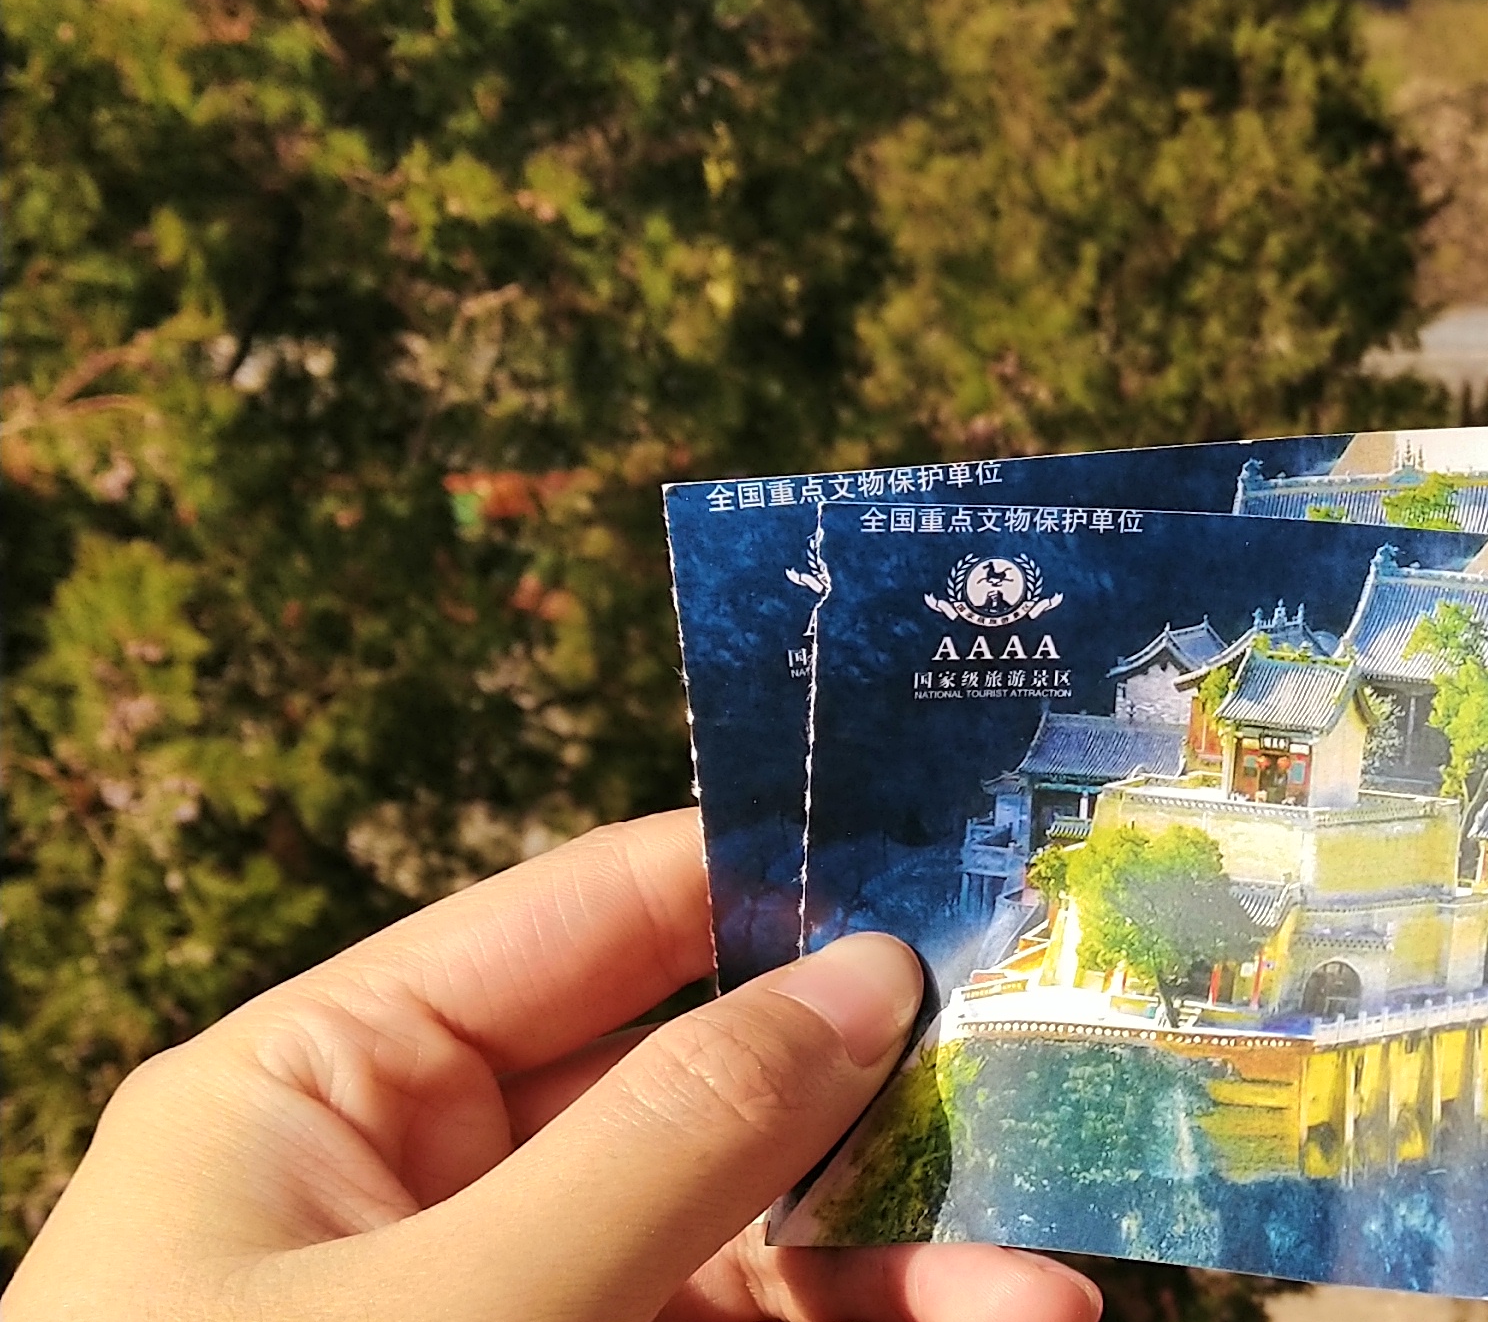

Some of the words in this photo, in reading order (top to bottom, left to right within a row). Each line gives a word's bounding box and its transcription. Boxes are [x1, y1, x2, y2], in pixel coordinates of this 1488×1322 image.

[705, 460, 1004, 513] 全国重点文物保护单位
[859, 506, 1145, 534] 全国重点文物保护单位
[931, 634, 1061, 662] AAAA
[913, 670, 1073, 690] 国家级旅游景区
[914, 689, 963, 700] NATIONAL
[966, 689, 1007, 698] TOURIST
[1010, 688, 1072, 698] ATTRACTION
